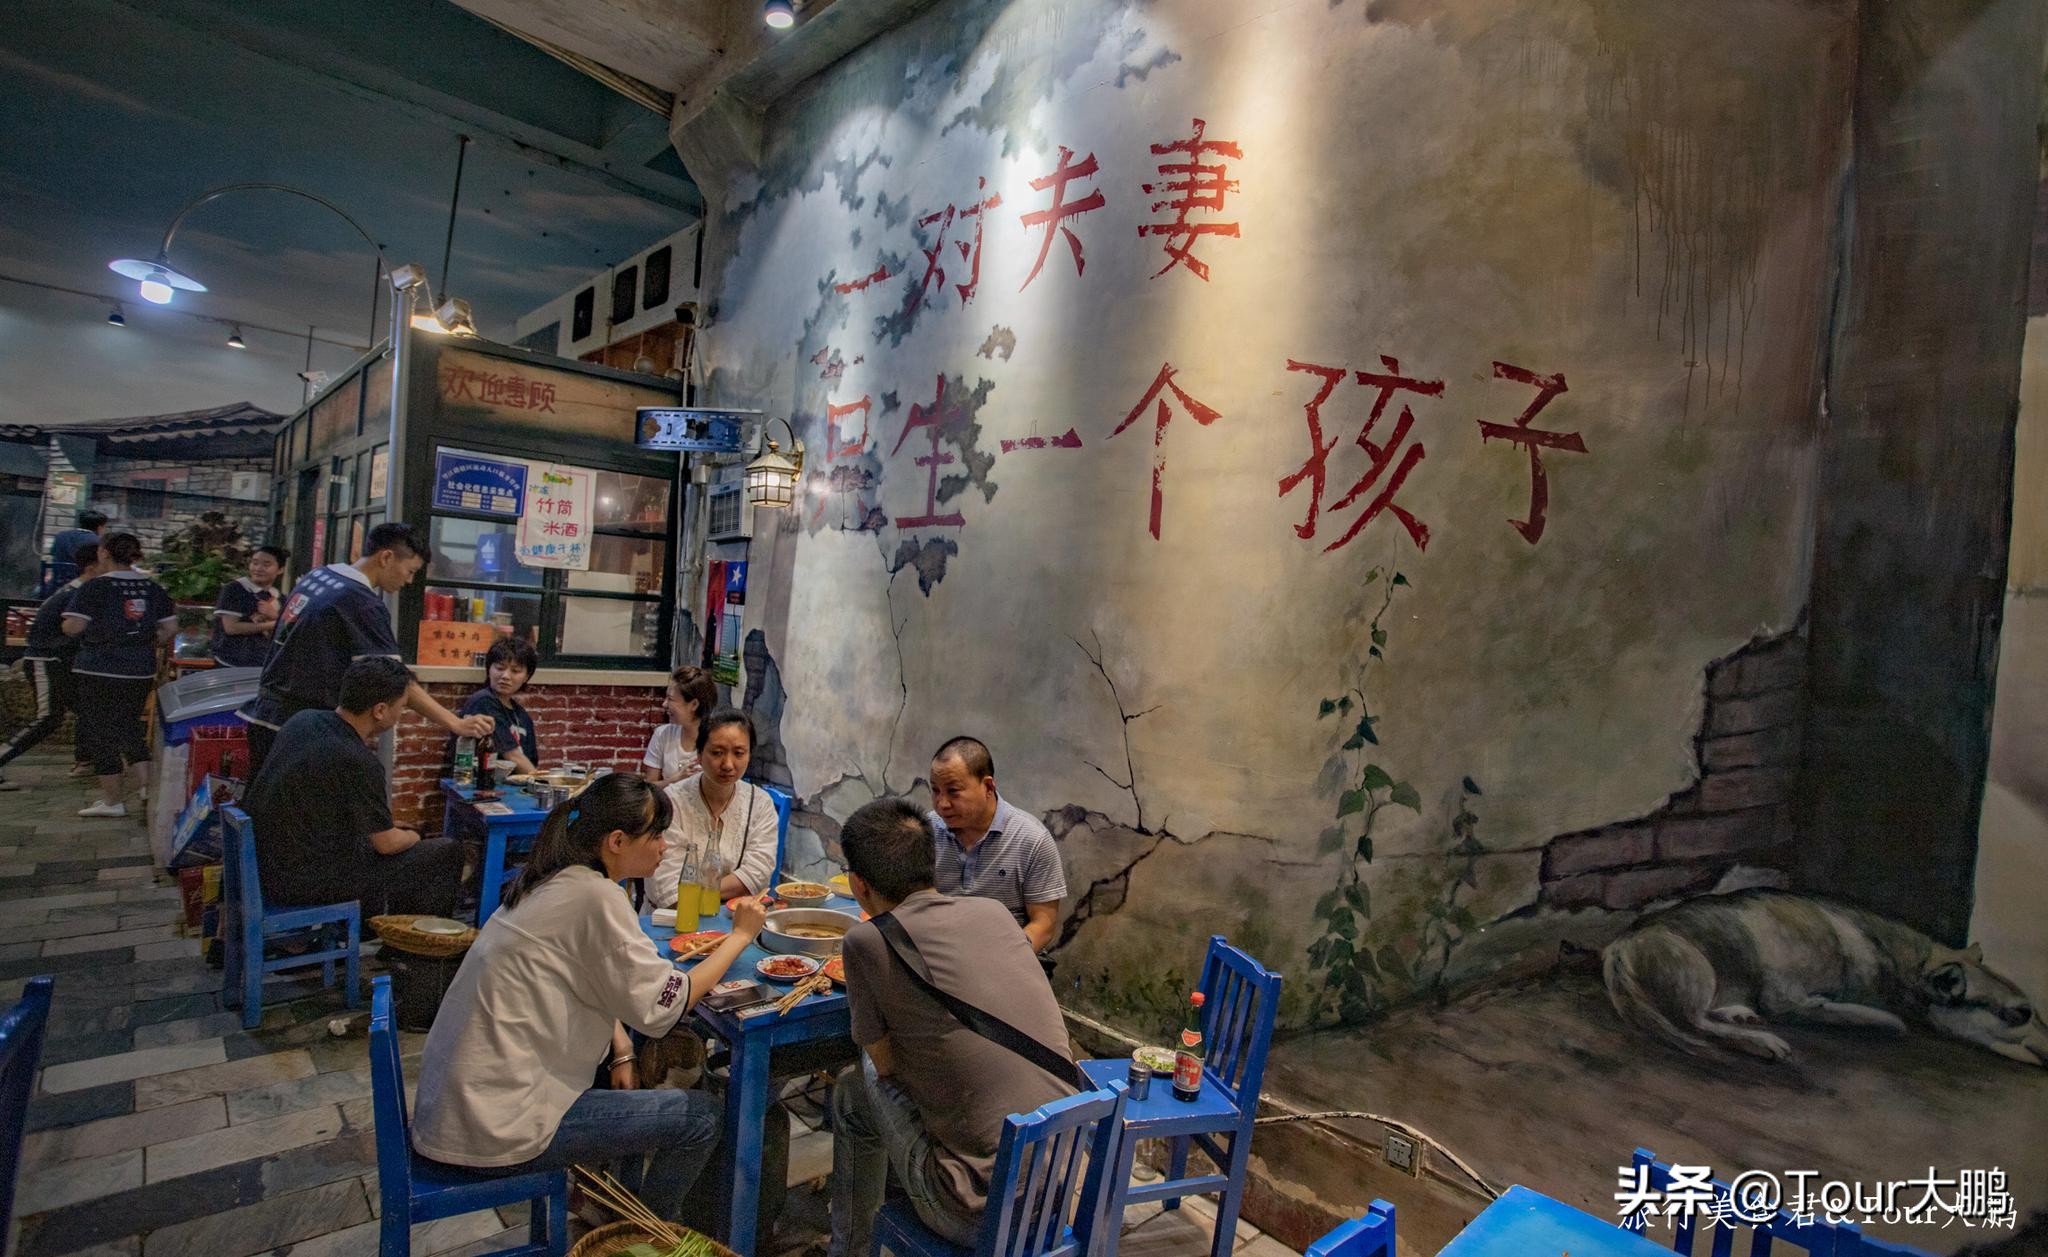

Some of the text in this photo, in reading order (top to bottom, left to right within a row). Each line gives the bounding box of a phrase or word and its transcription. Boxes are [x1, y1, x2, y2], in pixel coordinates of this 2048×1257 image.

[834, 117, 1244, 316] 一对夫妻
[443, 365, 556, 414] 欢迎惠顾
[536, 497, 574, 517] 竹筒
[543, 520, 579, 538] 米酒
